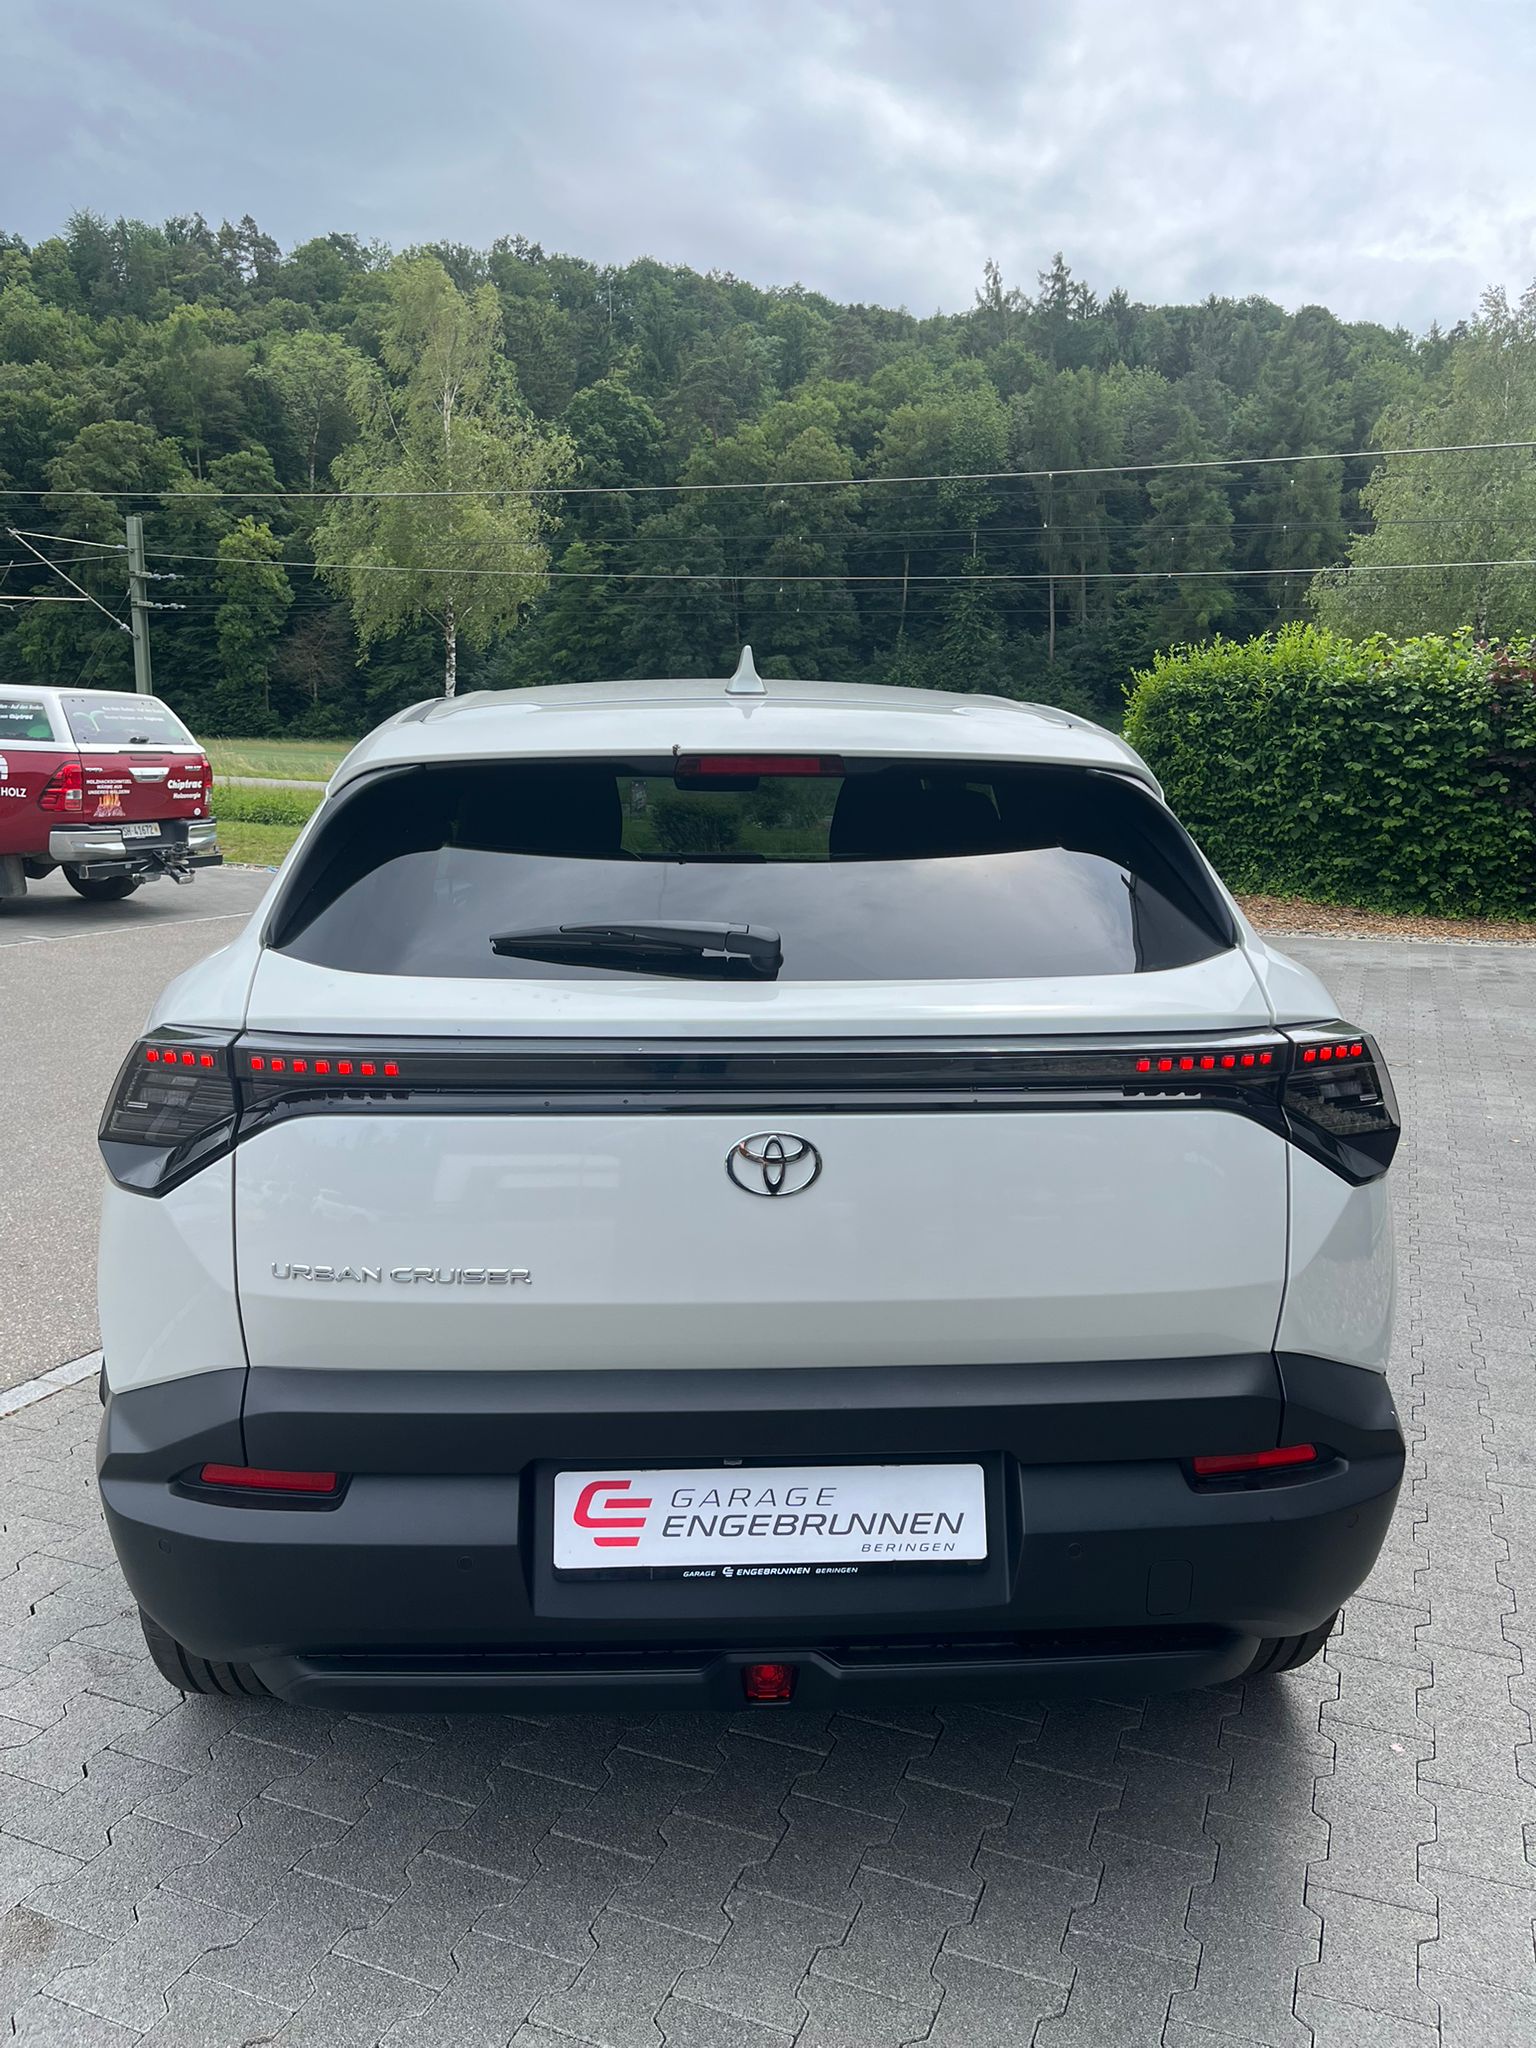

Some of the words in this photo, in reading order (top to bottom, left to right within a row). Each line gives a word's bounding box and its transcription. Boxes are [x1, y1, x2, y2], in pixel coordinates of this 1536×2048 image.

[167, 779, 203, 791] Chiptrac
[0, 786, 27, 798] HOLZ
[271, 1262, 382, 1284] URBAN
[389, 1265, 533, 1286] CRUISER
[670, 1486, 838, 1509] GARAGE
[662, 1512, 965, 1538] ENGEBRUNNEN
[861, 1542, 957, 1554] BERINGEN
[682, 1569, 717, 1578] GARAGE
[736, 1566, 811, 1577] ENGEBRUNNEN
[815, 1566, 859, 1575] BERINGEN
